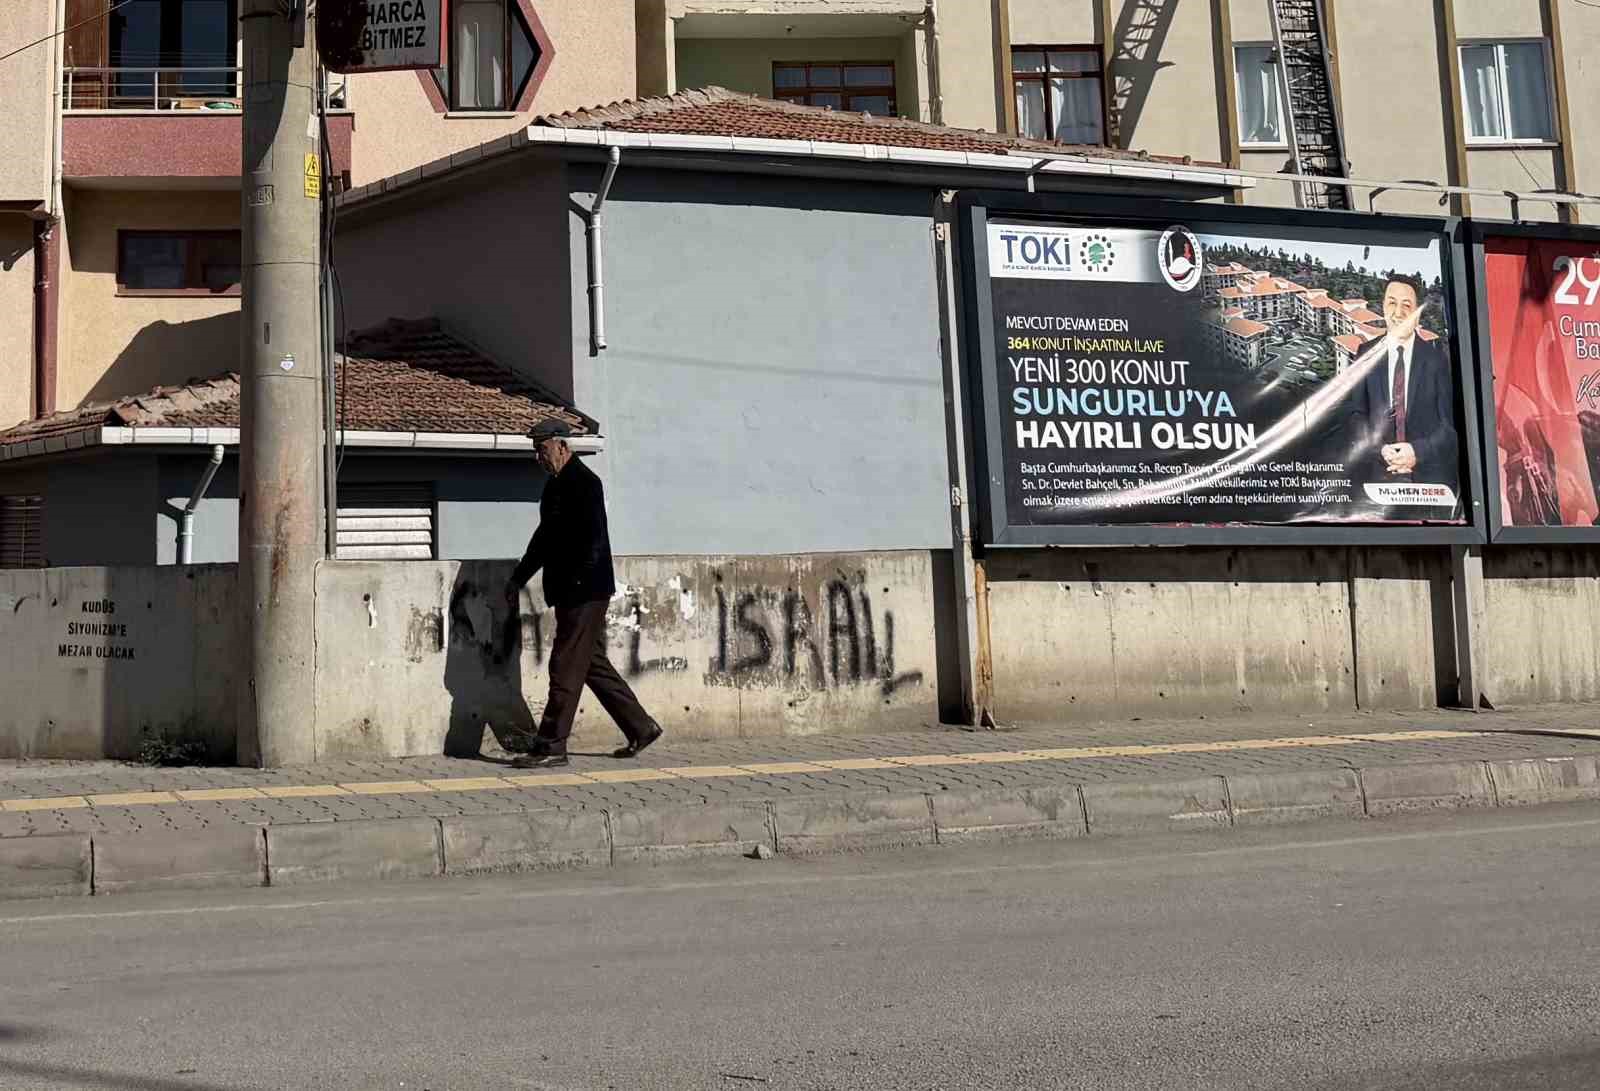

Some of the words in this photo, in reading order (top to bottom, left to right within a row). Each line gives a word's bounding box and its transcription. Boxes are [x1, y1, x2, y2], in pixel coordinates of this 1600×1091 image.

[1006, 316, 1054, 330] MEVCUT
[1056, 317, 1097, 331] DEVAM
[1098, 319, 1129, 332] EDEN
[1007, 336, 1030, 350] 364
[1032, 337, 1072, 351] KONUT
[1073, 335, 1133, 354] İNŞAATINA
[1134, 337, 1165, 353] İLAVE
[1008, 352, 1060, 383] YENİ
[1065, 358, 1106, 384] 300
[1110, 360, 1190, 386] KONUT
[1016, 420, 1142, 449] HAYIRLI
[1151, 422, 1257, 451] OLSUN
[1020, 462, 1047, 476] Başta
[1139, 462, 1153, 474] Sn.
[1154, 463, 1182, 476] Recep
[1256, 463, 1268, 472] ve
[1269, 461, 1294, 472] Genel
[1295, 461, 1345, 474] Başkanımız
[1022, 478, 1037, 490] Sn.
[1038, 479, 1052, 490] Dr.
[1053, 479, 1084, 490] Devlet
[1122, 478, 1137, 490] Sn.
[1268, 479, 1280, 488] ve
[1301, 476, 1353, 490] Başkanımız
[1023, 495, 1053, 507] olmak
[1054, 494, 1081, 507] üzere
[1209, 492, 1233, 504] adına
[1234, 492, 1297, 506] teşekkürlerimi
[58, 644, 92, 657] MEZAR
[96, 646, 135, 660] OLACAK
